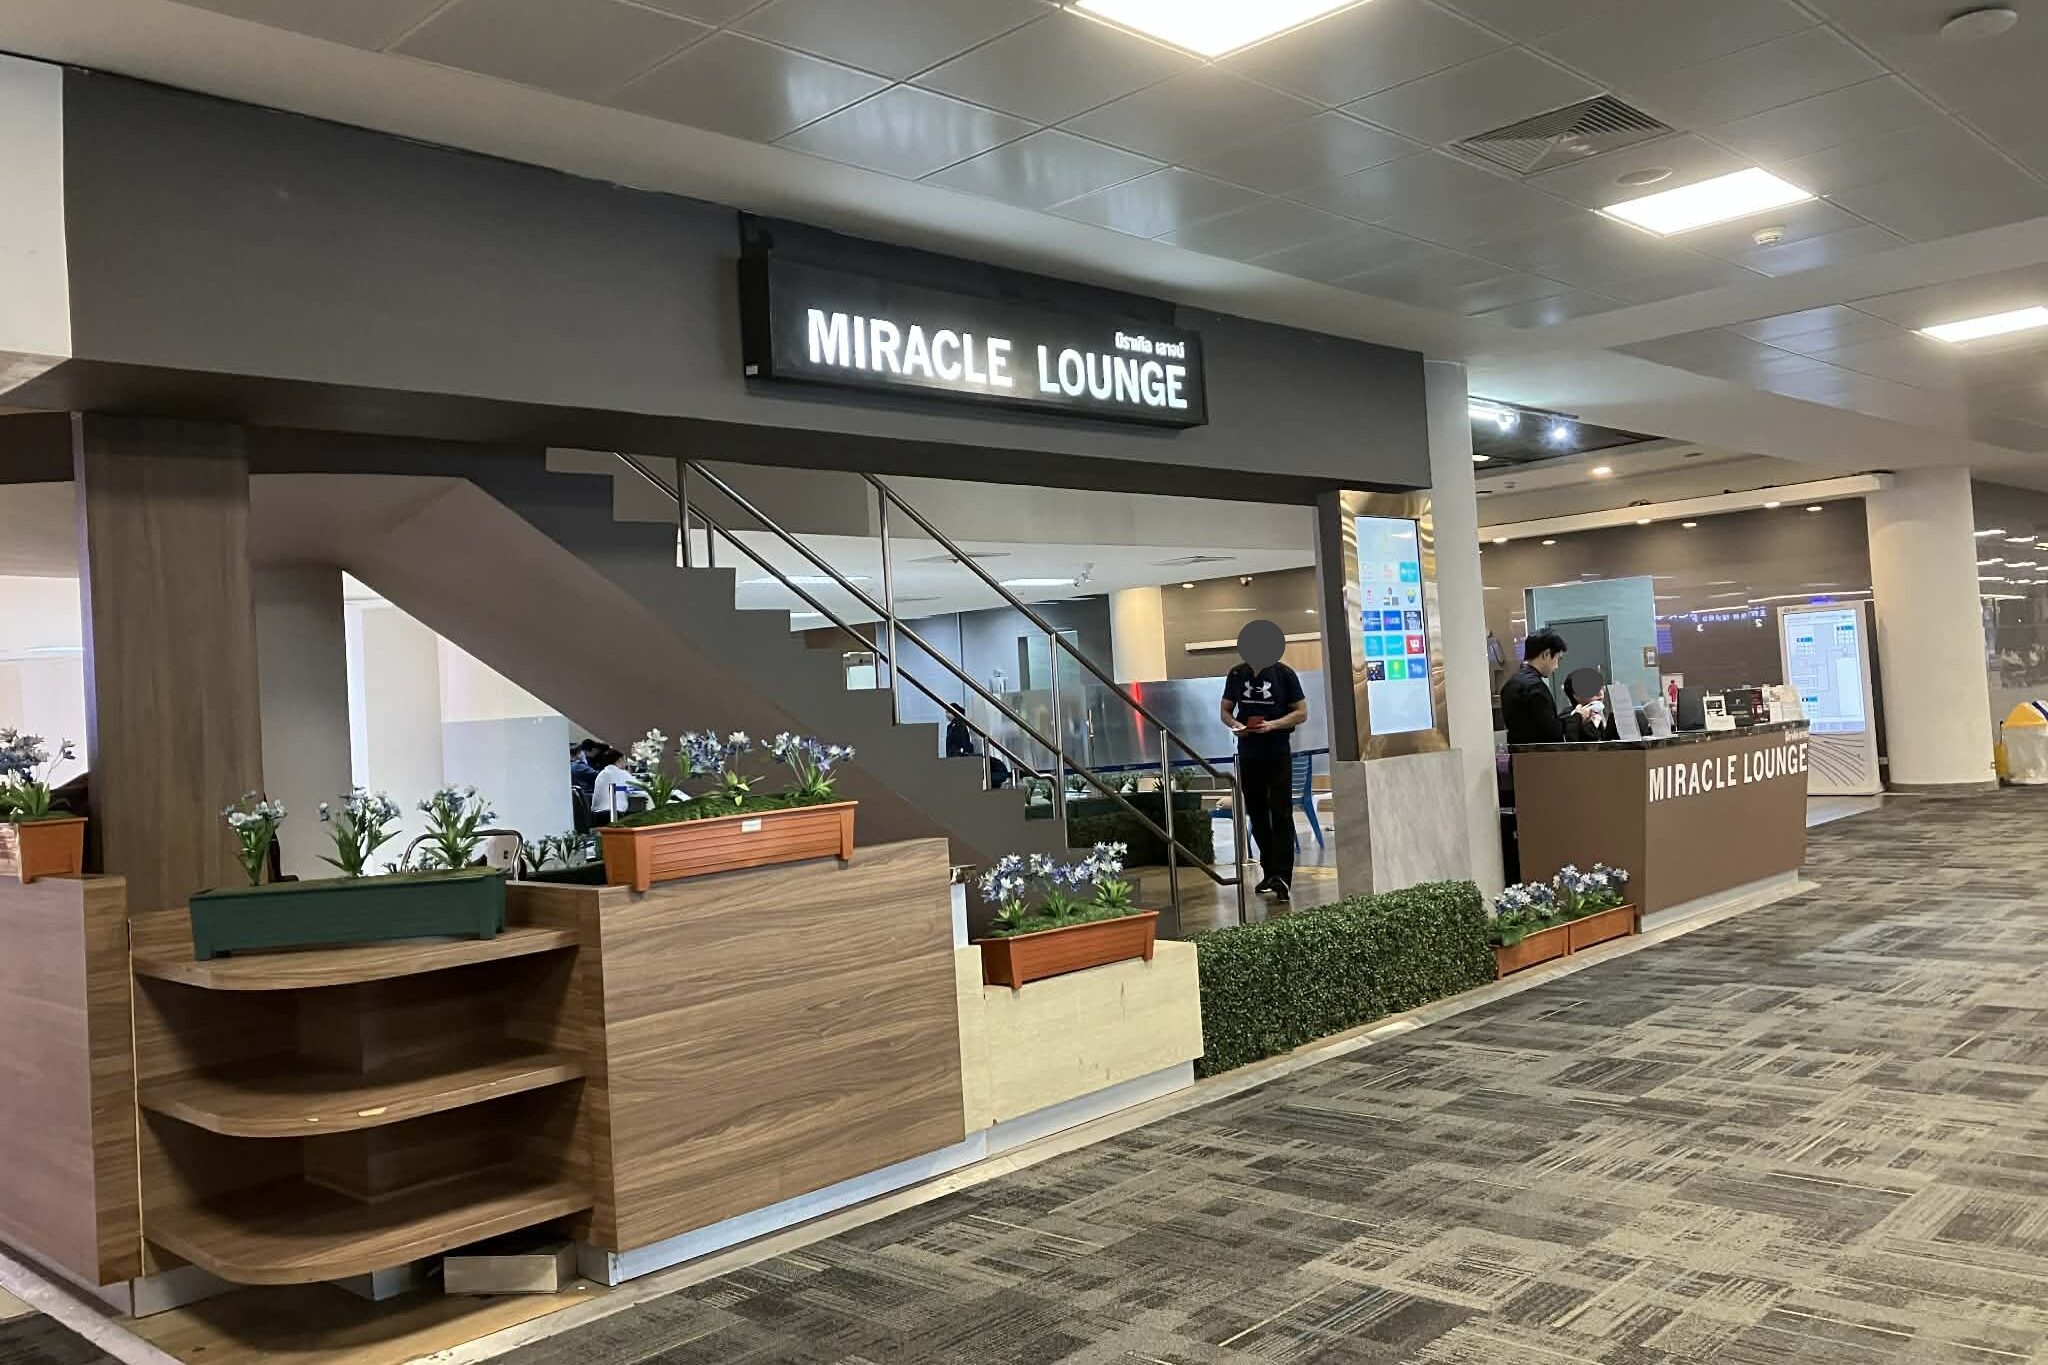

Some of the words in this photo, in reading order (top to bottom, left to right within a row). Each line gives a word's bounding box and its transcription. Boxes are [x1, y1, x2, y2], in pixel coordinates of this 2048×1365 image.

[807, 308, 1013, 388] MIRACLE
[1037, 344, 1188, 409] LOUNGE
[1649, 754, 1738, 803] MIRACLE
[1743, 742, 1808, 784] LOUNGE
